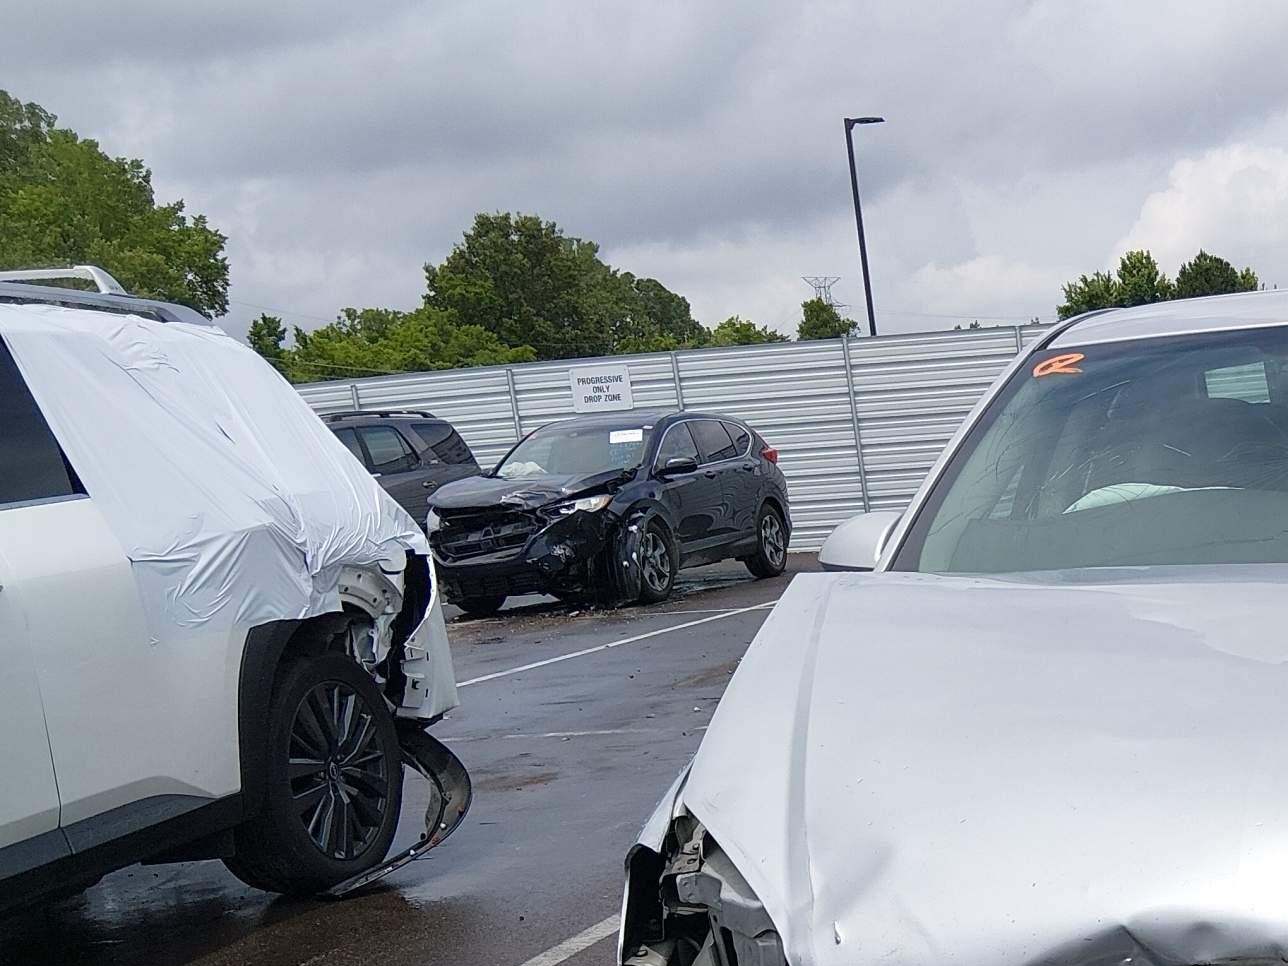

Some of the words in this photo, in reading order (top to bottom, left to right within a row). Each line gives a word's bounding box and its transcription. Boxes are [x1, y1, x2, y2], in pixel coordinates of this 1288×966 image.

[577, 375, 623, 385] PROGRESSIVE
[592, 385, 610, 393] ONLY
[583, 395, 602, 403] DROP
[604, 393, 621, 402] ZONE
